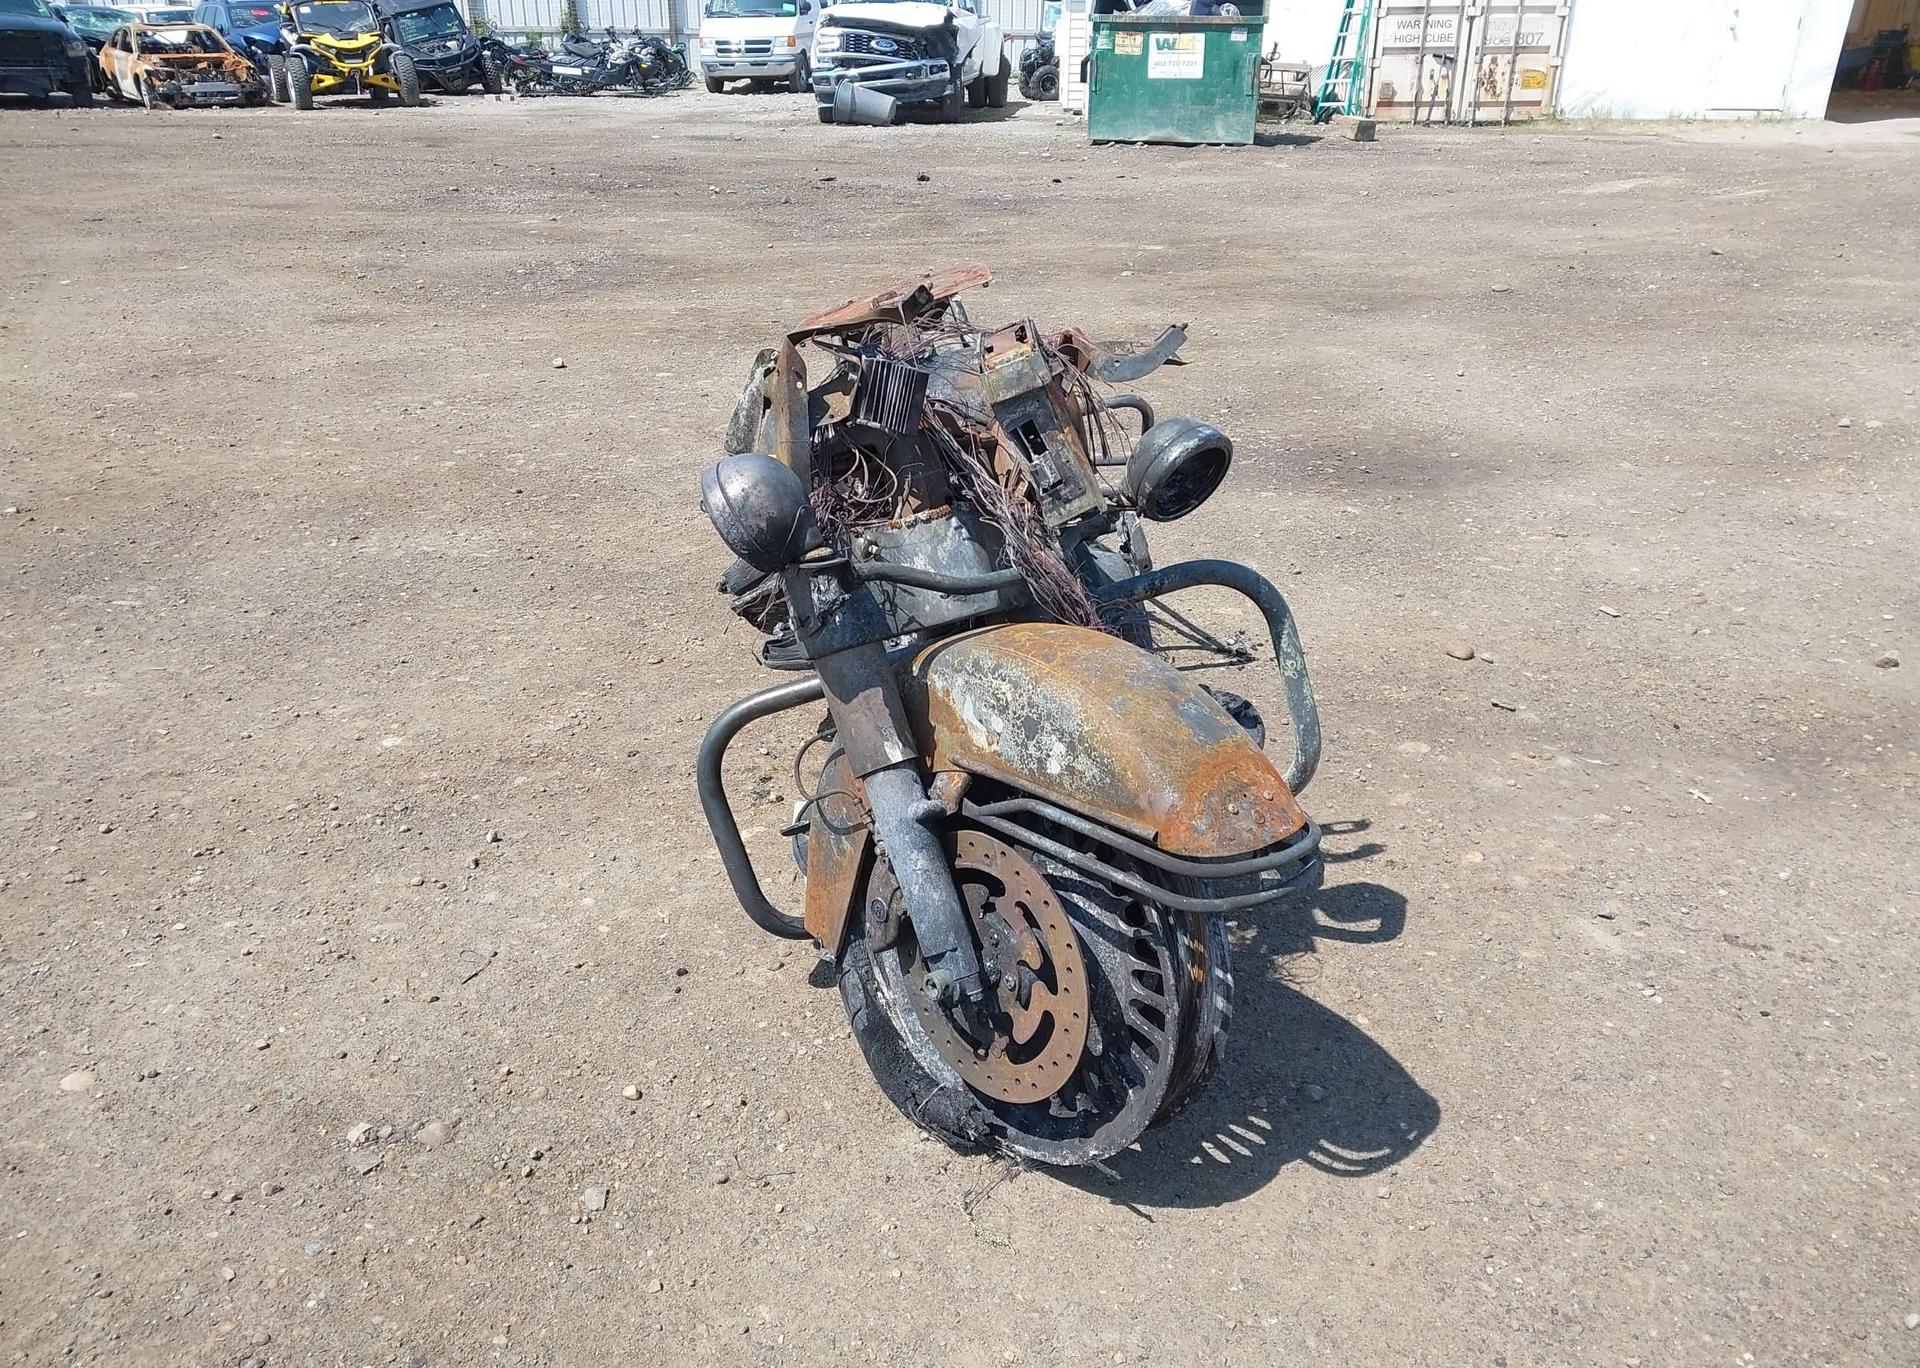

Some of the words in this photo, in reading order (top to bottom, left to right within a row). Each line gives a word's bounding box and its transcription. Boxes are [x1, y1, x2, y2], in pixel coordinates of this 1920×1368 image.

[1397, 19, 1453, 30] WARNING
[1394, 33, 1421, 43] HIGH
[1424, 33, 1454, 43] CUBE
